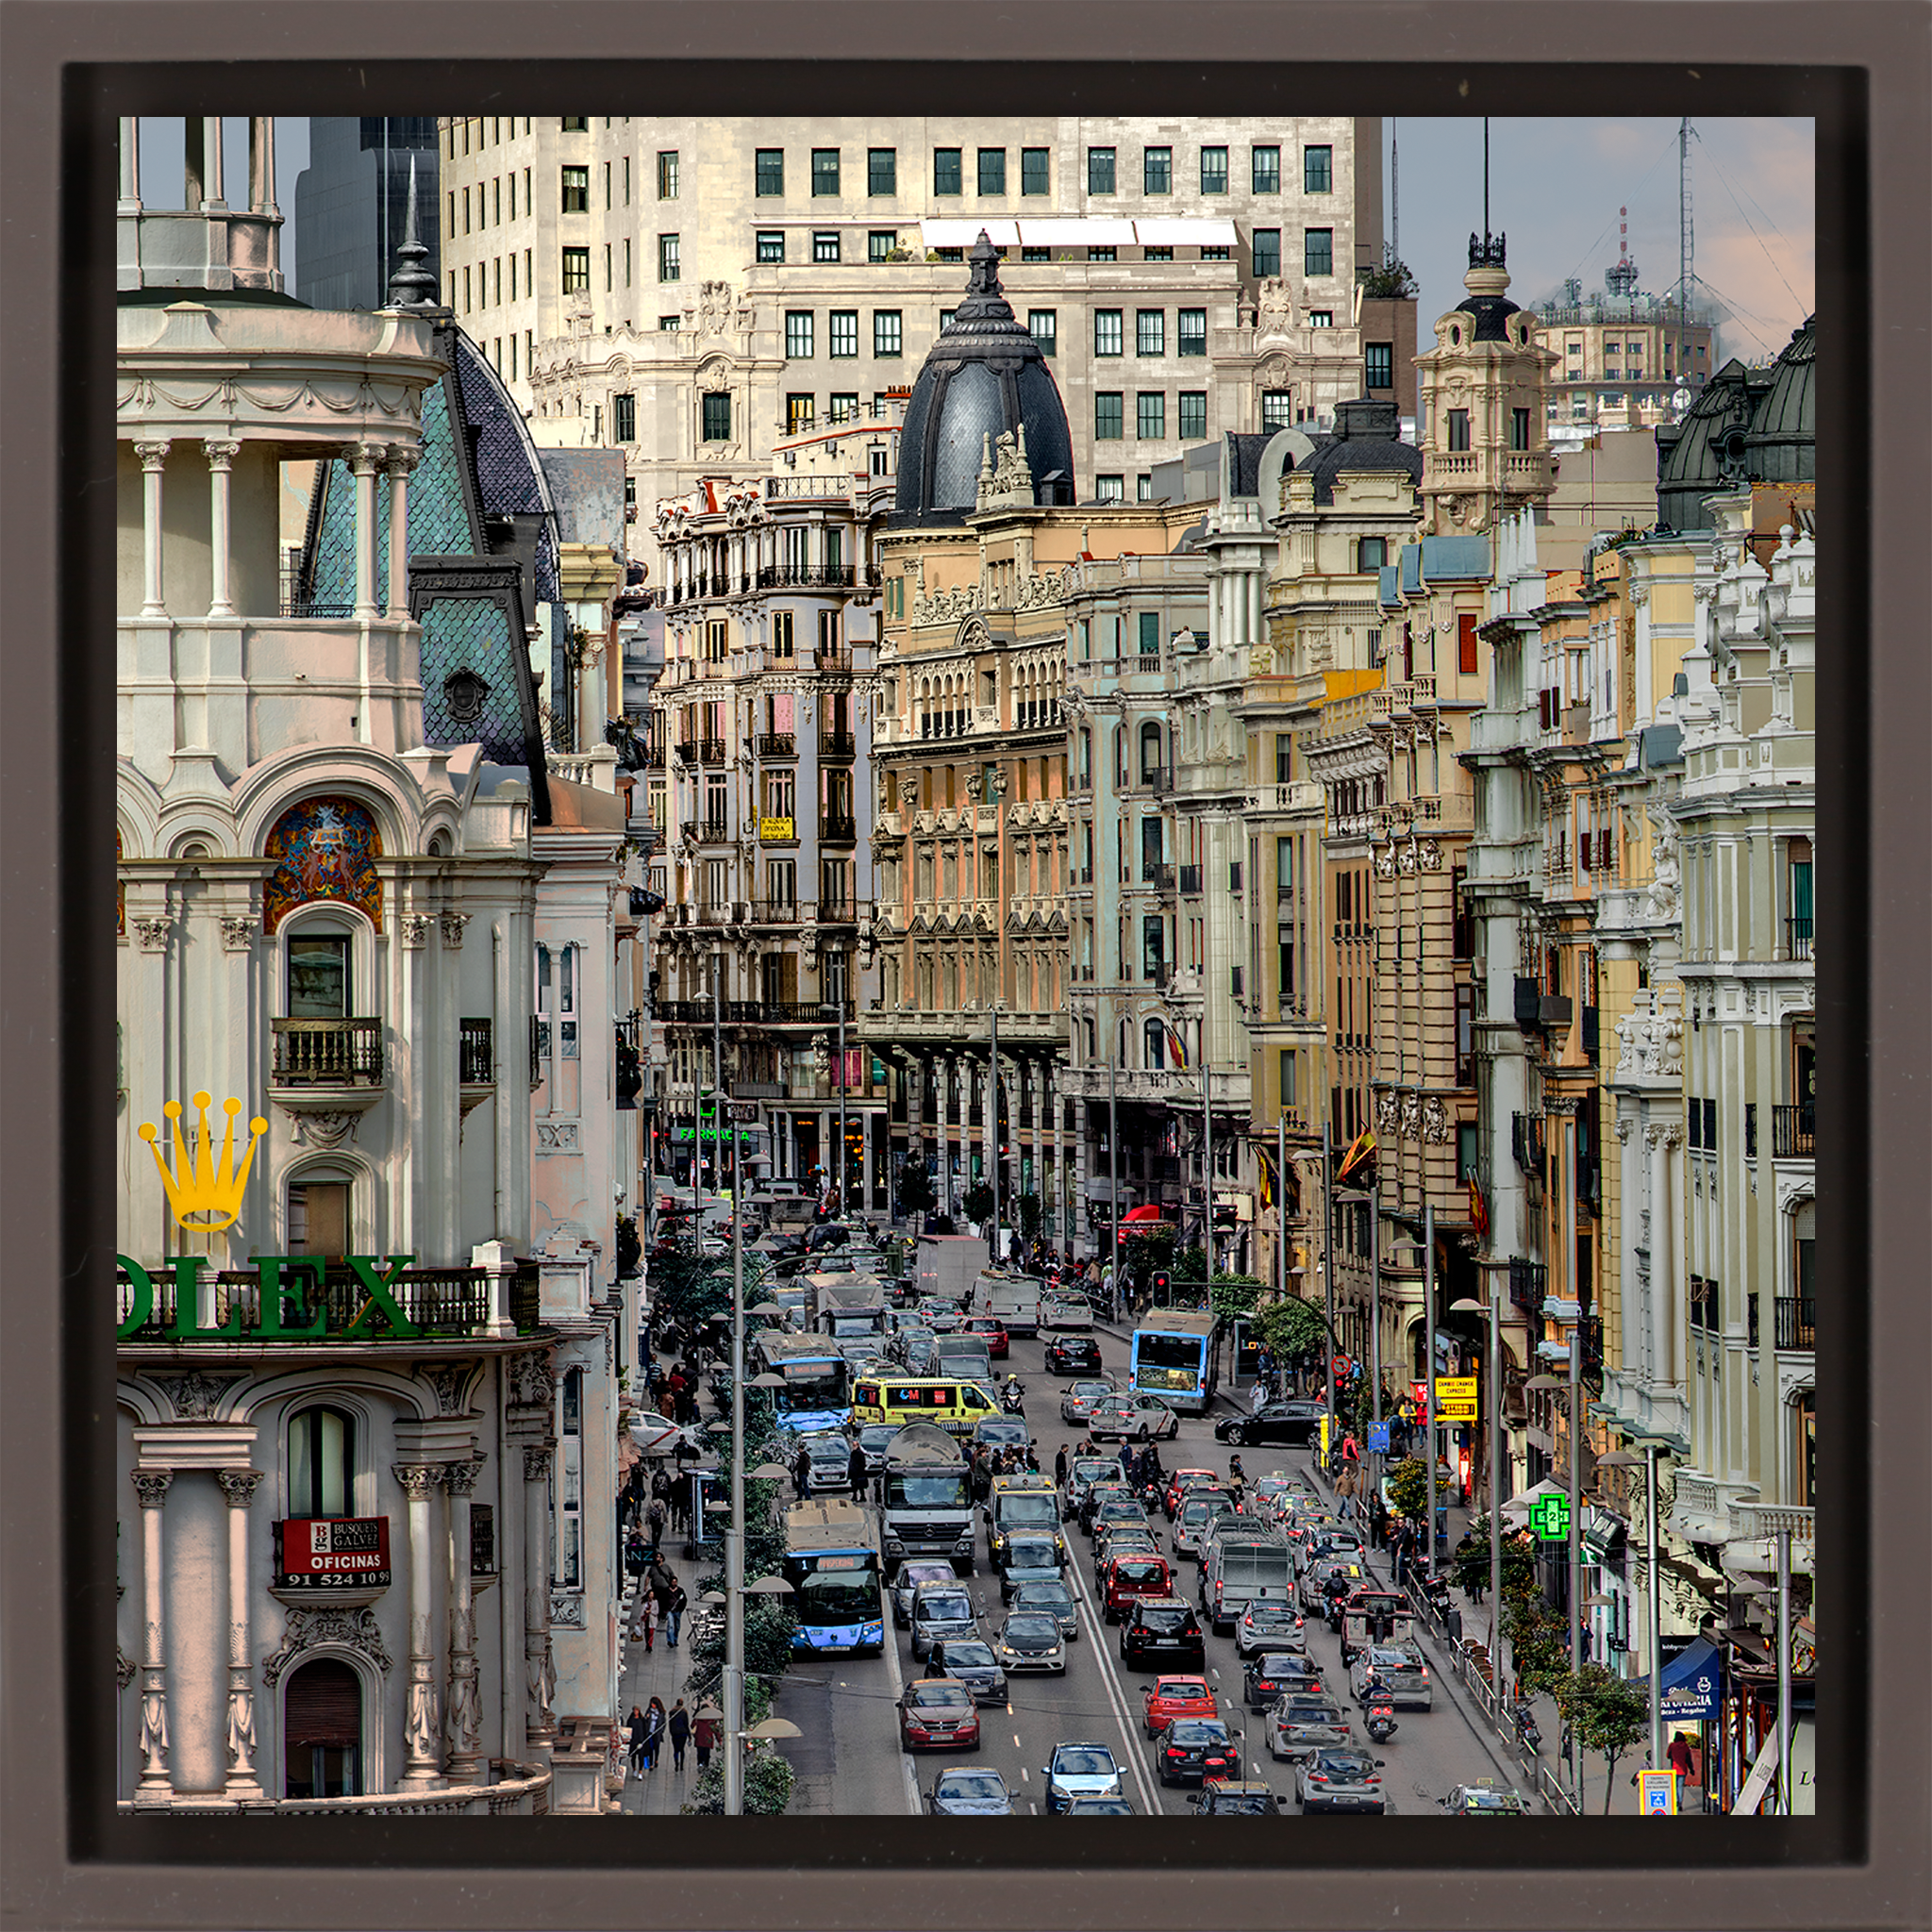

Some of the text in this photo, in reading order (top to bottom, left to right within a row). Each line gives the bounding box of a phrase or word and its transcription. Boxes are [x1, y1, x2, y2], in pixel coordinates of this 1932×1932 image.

[680, 1129, 750, 1141] FARMACA
[333, 1522, 378, 1536] BUSQUETS
[333, 1534, 378, 1547] GALVEZ
[310, 1554, 381, 1570] OFICINAS
[288, 1574, 312, 1586] 91
[320, 1574, 354, 1586] 524
[359, 1572, 376, 1584] 10
